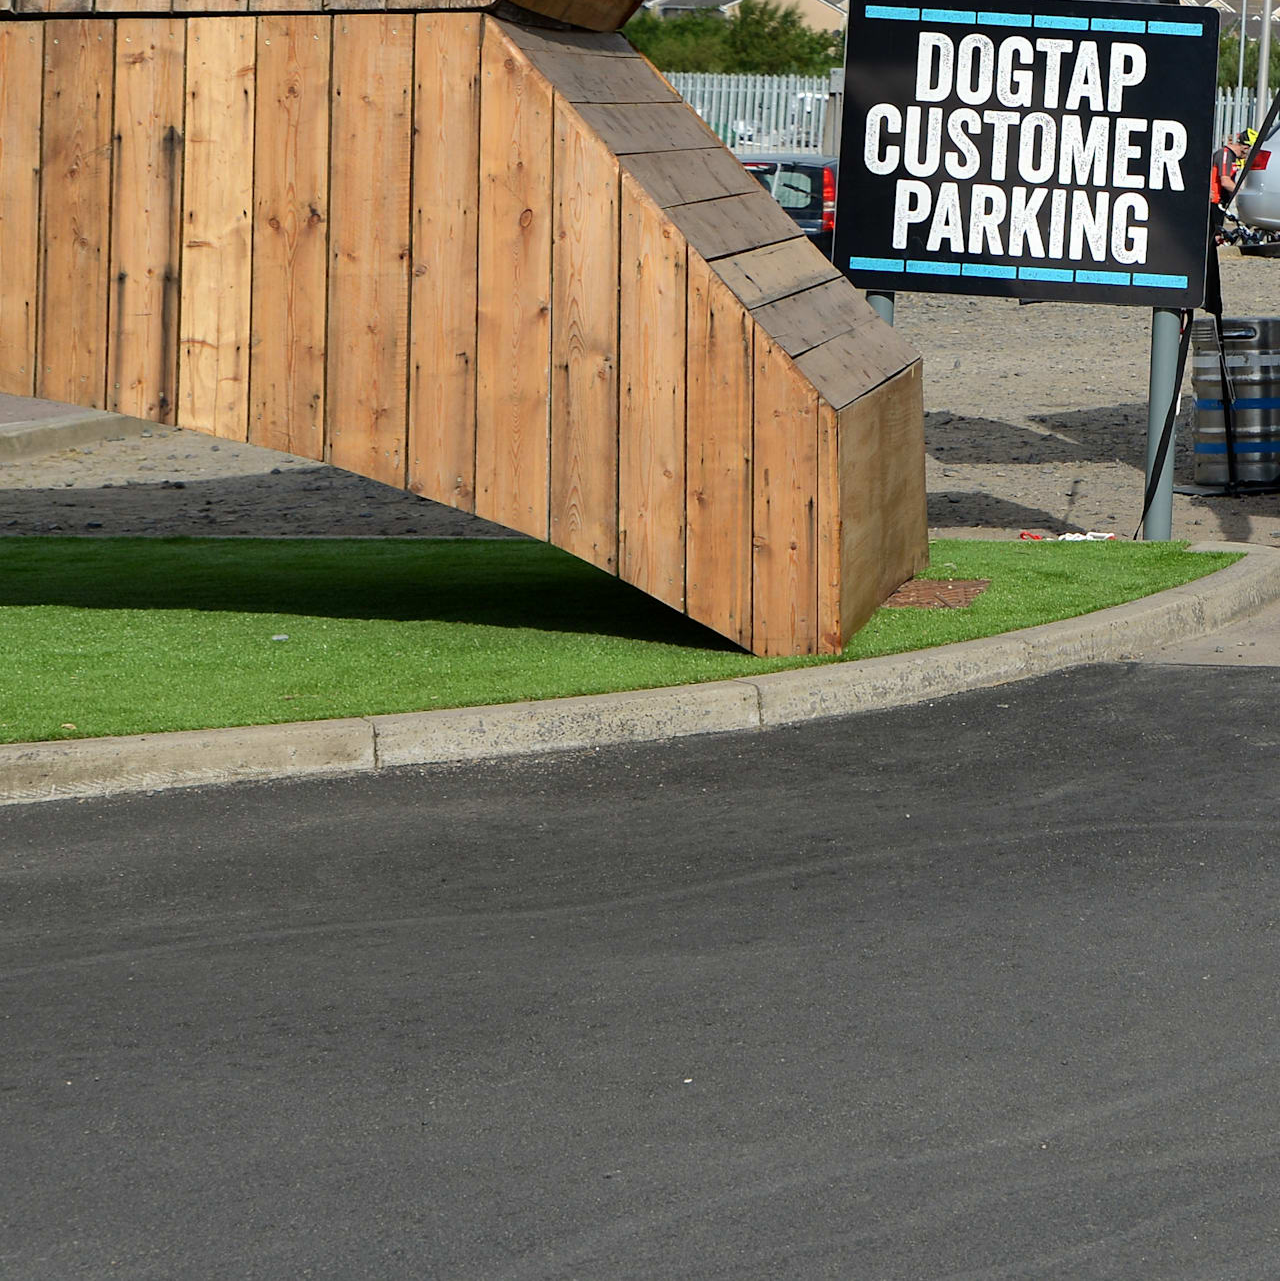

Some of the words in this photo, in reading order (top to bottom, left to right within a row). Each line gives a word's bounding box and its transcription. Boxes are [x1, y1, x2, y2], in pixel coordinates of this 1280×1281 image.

[915, 31, 1147, 113] DOGTAP
[863, 102, 1188, 192] CUSTOMER
[892, 178, 1150, 265] PARKING
